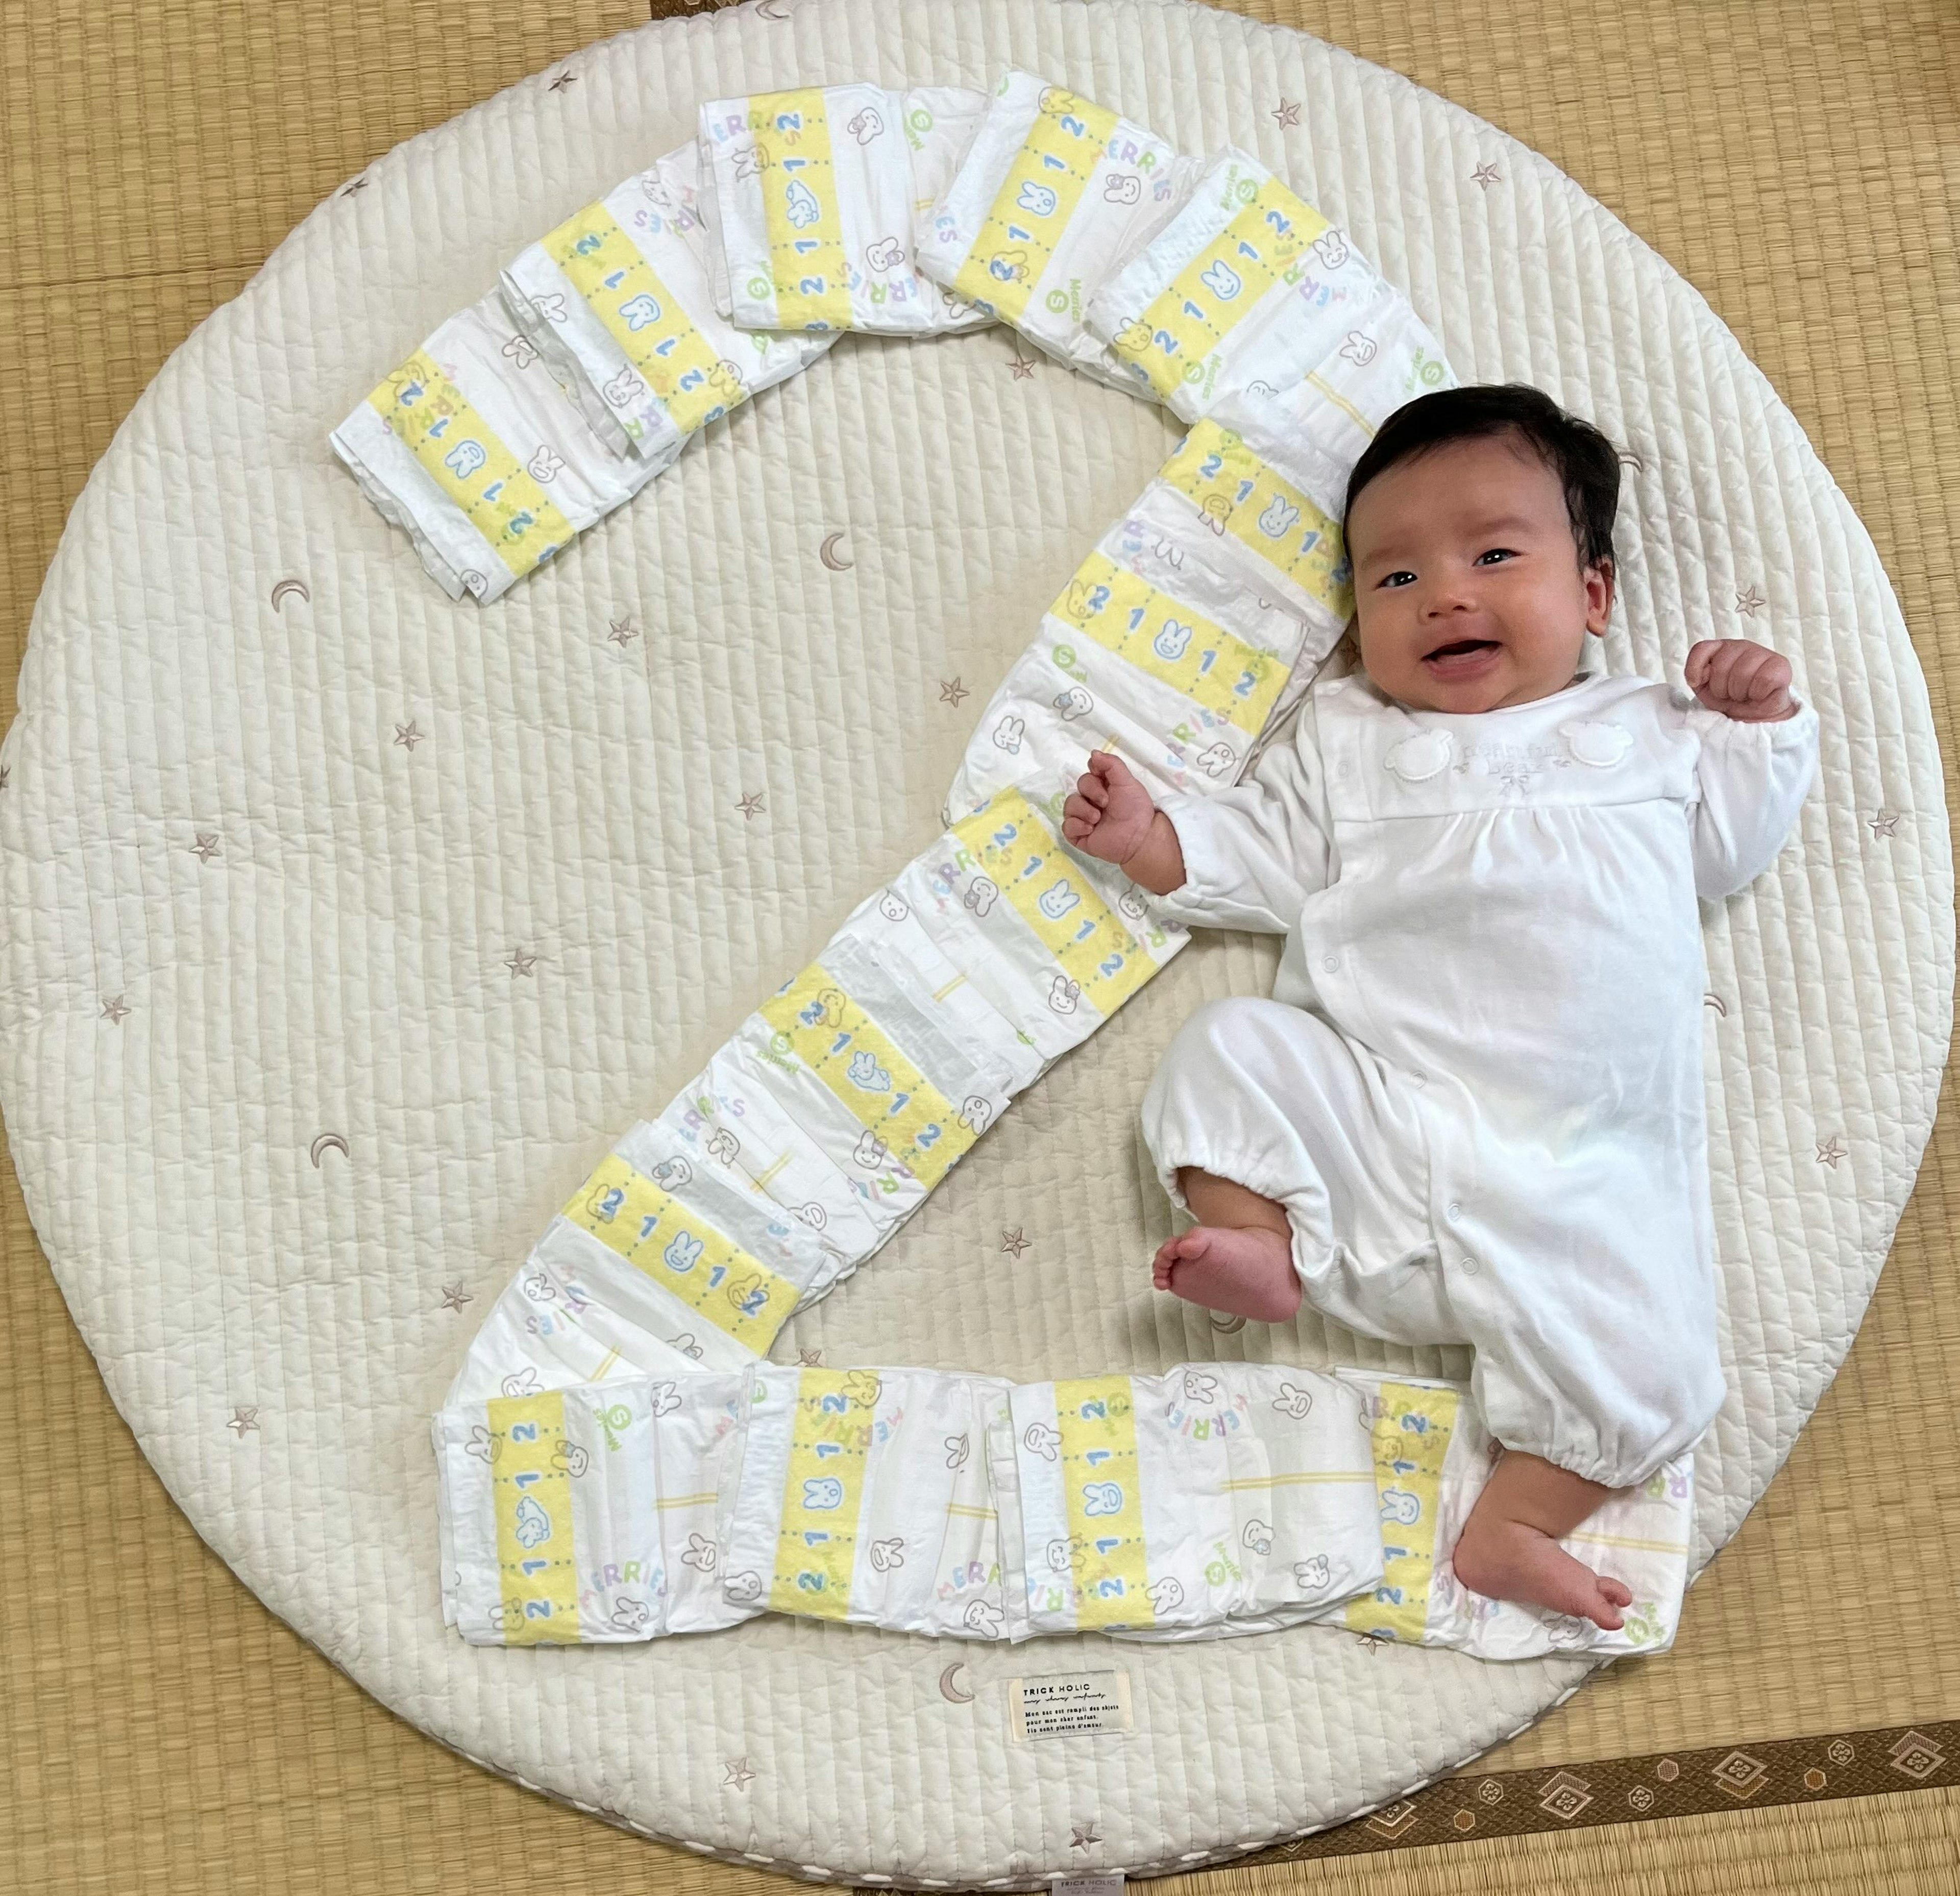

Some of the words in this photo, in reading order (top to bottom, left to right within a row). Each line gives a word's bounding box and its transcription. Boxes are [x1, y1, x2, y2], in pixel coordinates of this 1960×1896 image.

[777, 113, 801, 130] 2
[1061, 116, 1084, 137] 2
[783, 160, 805, 172] 1
[1043, 155, 1065, 169] 1
[1266, 211, 1290, 233] 2
[1009, 226, 1030, 240] 1
[795, 240, 818, 253] 1
[1239, 242, 1258, 259] 1
[990, 260, 1013, 280] 2
[800, 277, 824, 295] 2
[576, 235, 601, 255] 2
[605, 271, 625, 289] 1
[656, 338, 676, 356] 1
[680, 369, 704, 392] 2
[1184, 301, 1204, 319] 1
[1155, 331, 1178, 354] 2
[400, 381, 424, 406] 2
[429, 419, 448, 437] 1
[483, 482, 503, 501] 1
[510, 511, 534, 534] 2
[1200, 454, 1221, 478] 2
[1237, 480, 1254, 501] 1
[1302, 531, 1319, 553] 1
[1089, 586, 1110, 610] 2
[1129, 609, 1145, 630] 1
[1202, 650, 1216, 672] 1
[1234, 671, 1256, 696] 2
[994, 823, 1016, 846] 2
[1024, 856, 1042, 876] 1
[1077, 920, 1095, 939] 1
[1100, 954, 1123, 977] 2
[800, 1001, 823, 1025] 2
[832, 1032, 851, 1052] 1
[890, 1092, 909, 1115] 1
[917, 1123, 941, 1148] 2
[602, 1188, 624, 1215] 2
[641, 1216, 657, 1237] 1
[710, 1266, 726, 1287] 1
[742, 1291, 766, 1316] 2
[823, 1396, 847, 1413] 2
[1081, 1401, 1106, 1419] 2
[512, 1424, 536, 1442] 2
[1402, 1415, 1426, 1433] 2
[816, 1444, 840, 1458] 1
[1086, 1451, 1110, 1466] 1
[1393, 1460, 1414, 1474] 1
[516, 1474, 539, 1488] 1
[804, 1532, 829, 1546] 1
[1096, 1538, 1119, 1553] 1
[1384, 1547, 1407, 1560] 1
[522, 1561, 547, 1575] 1
[798, 1572, 823, 1591] 2
[1099, 1579, 1123, 1598] 2
[1377, 1587, 1402, 1605] 2
[526, 1600, 550, 1618] 2
[1023, 1686, 1054, 1696] TRICK
[1059, 1684, 1090, 1692] HOLIC
